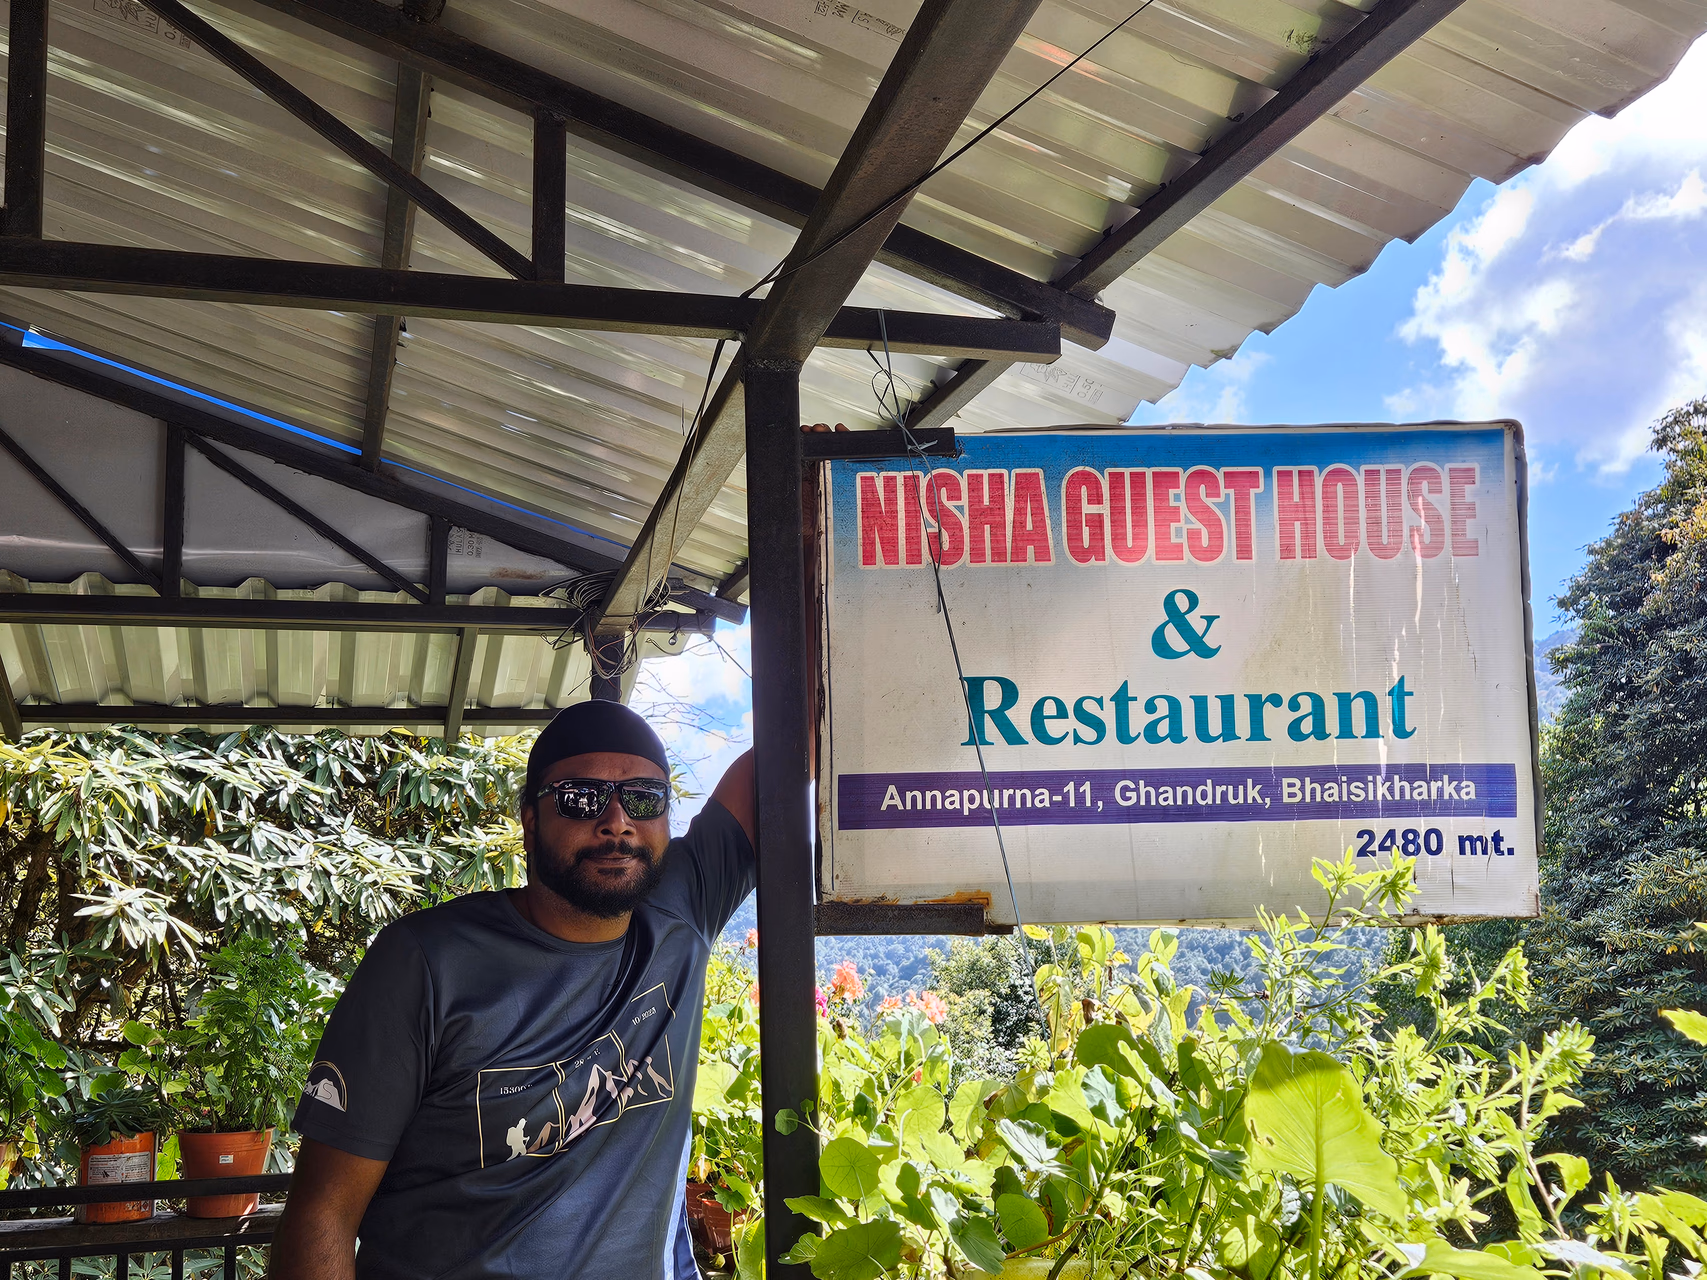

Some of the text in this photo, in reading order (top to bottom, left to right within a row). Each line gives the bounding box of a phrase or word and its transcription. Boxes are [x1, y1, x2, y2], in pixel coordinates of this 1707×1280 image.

[857, 461, 1480, 569] NISHA GUEST HOUSE
[1151, 588, 1221, 660] &
[962, 674, 1416, 747] Restaurant
[880, 774, 1477, 816] Annapurna-11, Ghandruk, Bhaisikharka
[1356, 827, 1515, 858] 2480 mt.
